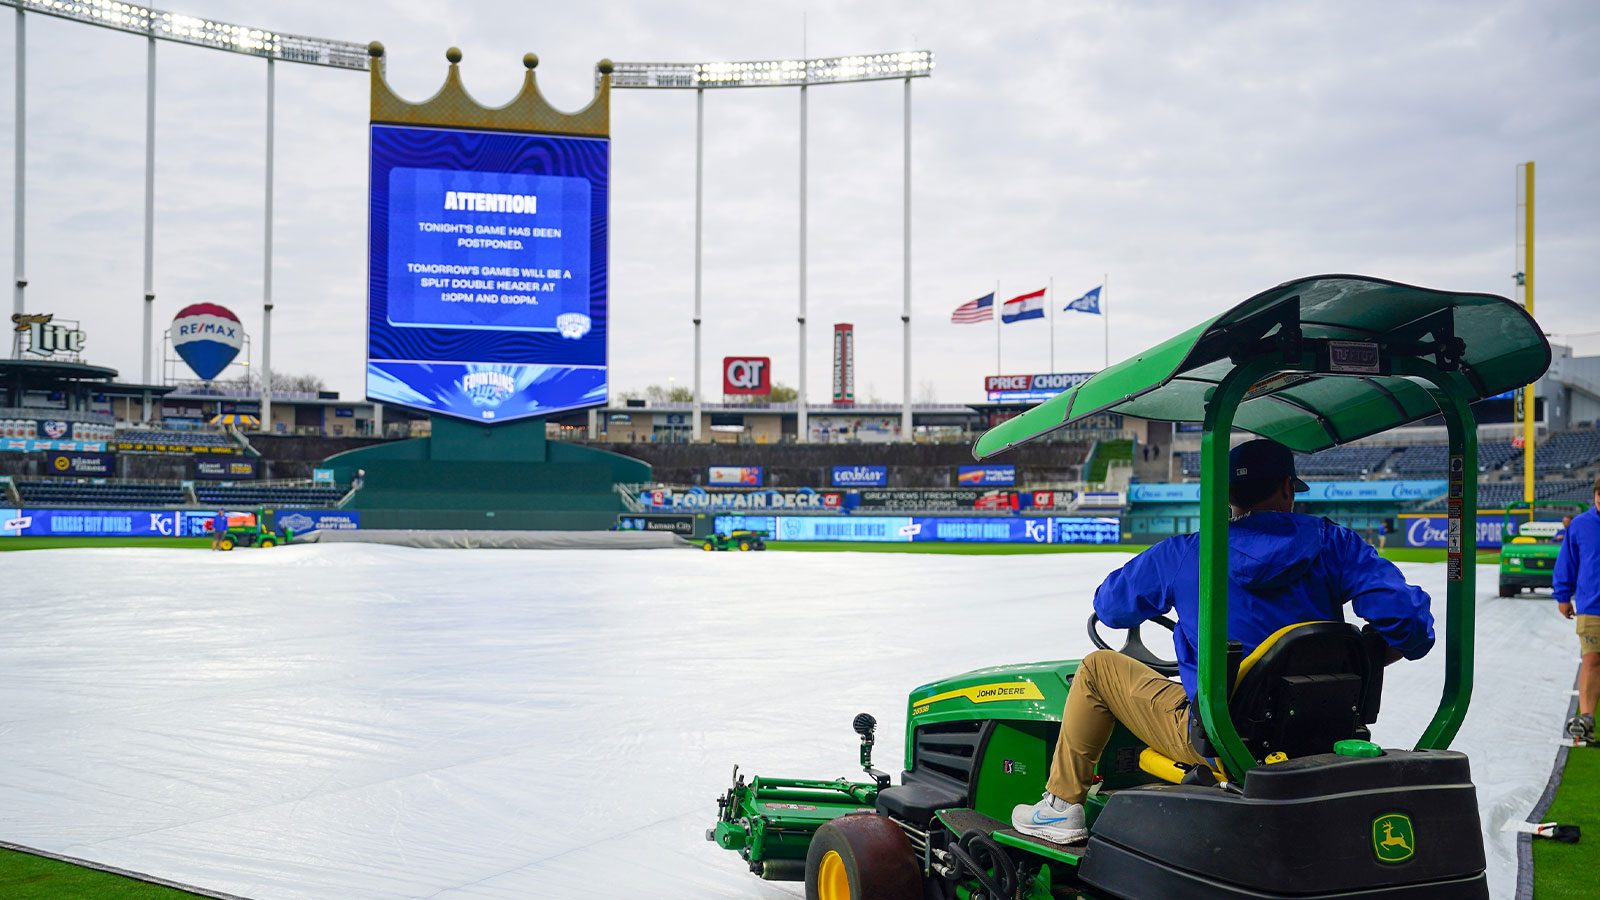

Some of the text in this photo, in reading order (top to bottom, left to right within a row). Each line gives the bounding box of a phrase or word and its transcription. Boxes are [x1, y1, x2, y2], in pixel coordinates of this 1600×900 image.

[444, 191, 536, 214] ATTENTION
[418, 222, 561, 238] TONIGHT'S GAME HAS BEEN
[457, 238, 524, 250] POSTPONED.
[407, 262, 572, 279] TOMORROW'S GAMES WILL BE A
[420, 278, 555, 292] SPLIT DOUBLE HEADER AT
[441, 292, 474, 302] 1:10PM
[475, 293, 499, 303] AND
[180, 322, 236, 338] RE/MAX
[27, 322, 87, 357] Lite
[463, 371, 514, 392] FOUNTAINS
[727, 360, 765, 389] QT
[989, 374, 1092, 389] PRICE CHOPPE
[672, 493, 767, 507] FOUNTAIN
[771, 493, 821, 507] DECK
[864, 492, 977, 500] GREAT VIEWS FRESH FOOD
[51, 516, 83, 532] KANSAS
[84, 516, 102, 532] CITY
[103, 516, 131, 532] ROYALS
[150, 513, 172, 535] KC
[648, 521, 691, 531] Kansas City
[815, 524, 885, 536] MILWAUKEE BREWERS
[937, 523, 965, 538] KANSAS
[966, 523, 982, 538] CITY
[983, 523, 1009, 538] ROYALS
[1025, 520, 1045, 542] KC
[1408, 517, 1448, 546] Circ
[977, 687, 1025, 698] JOHN DEERE
